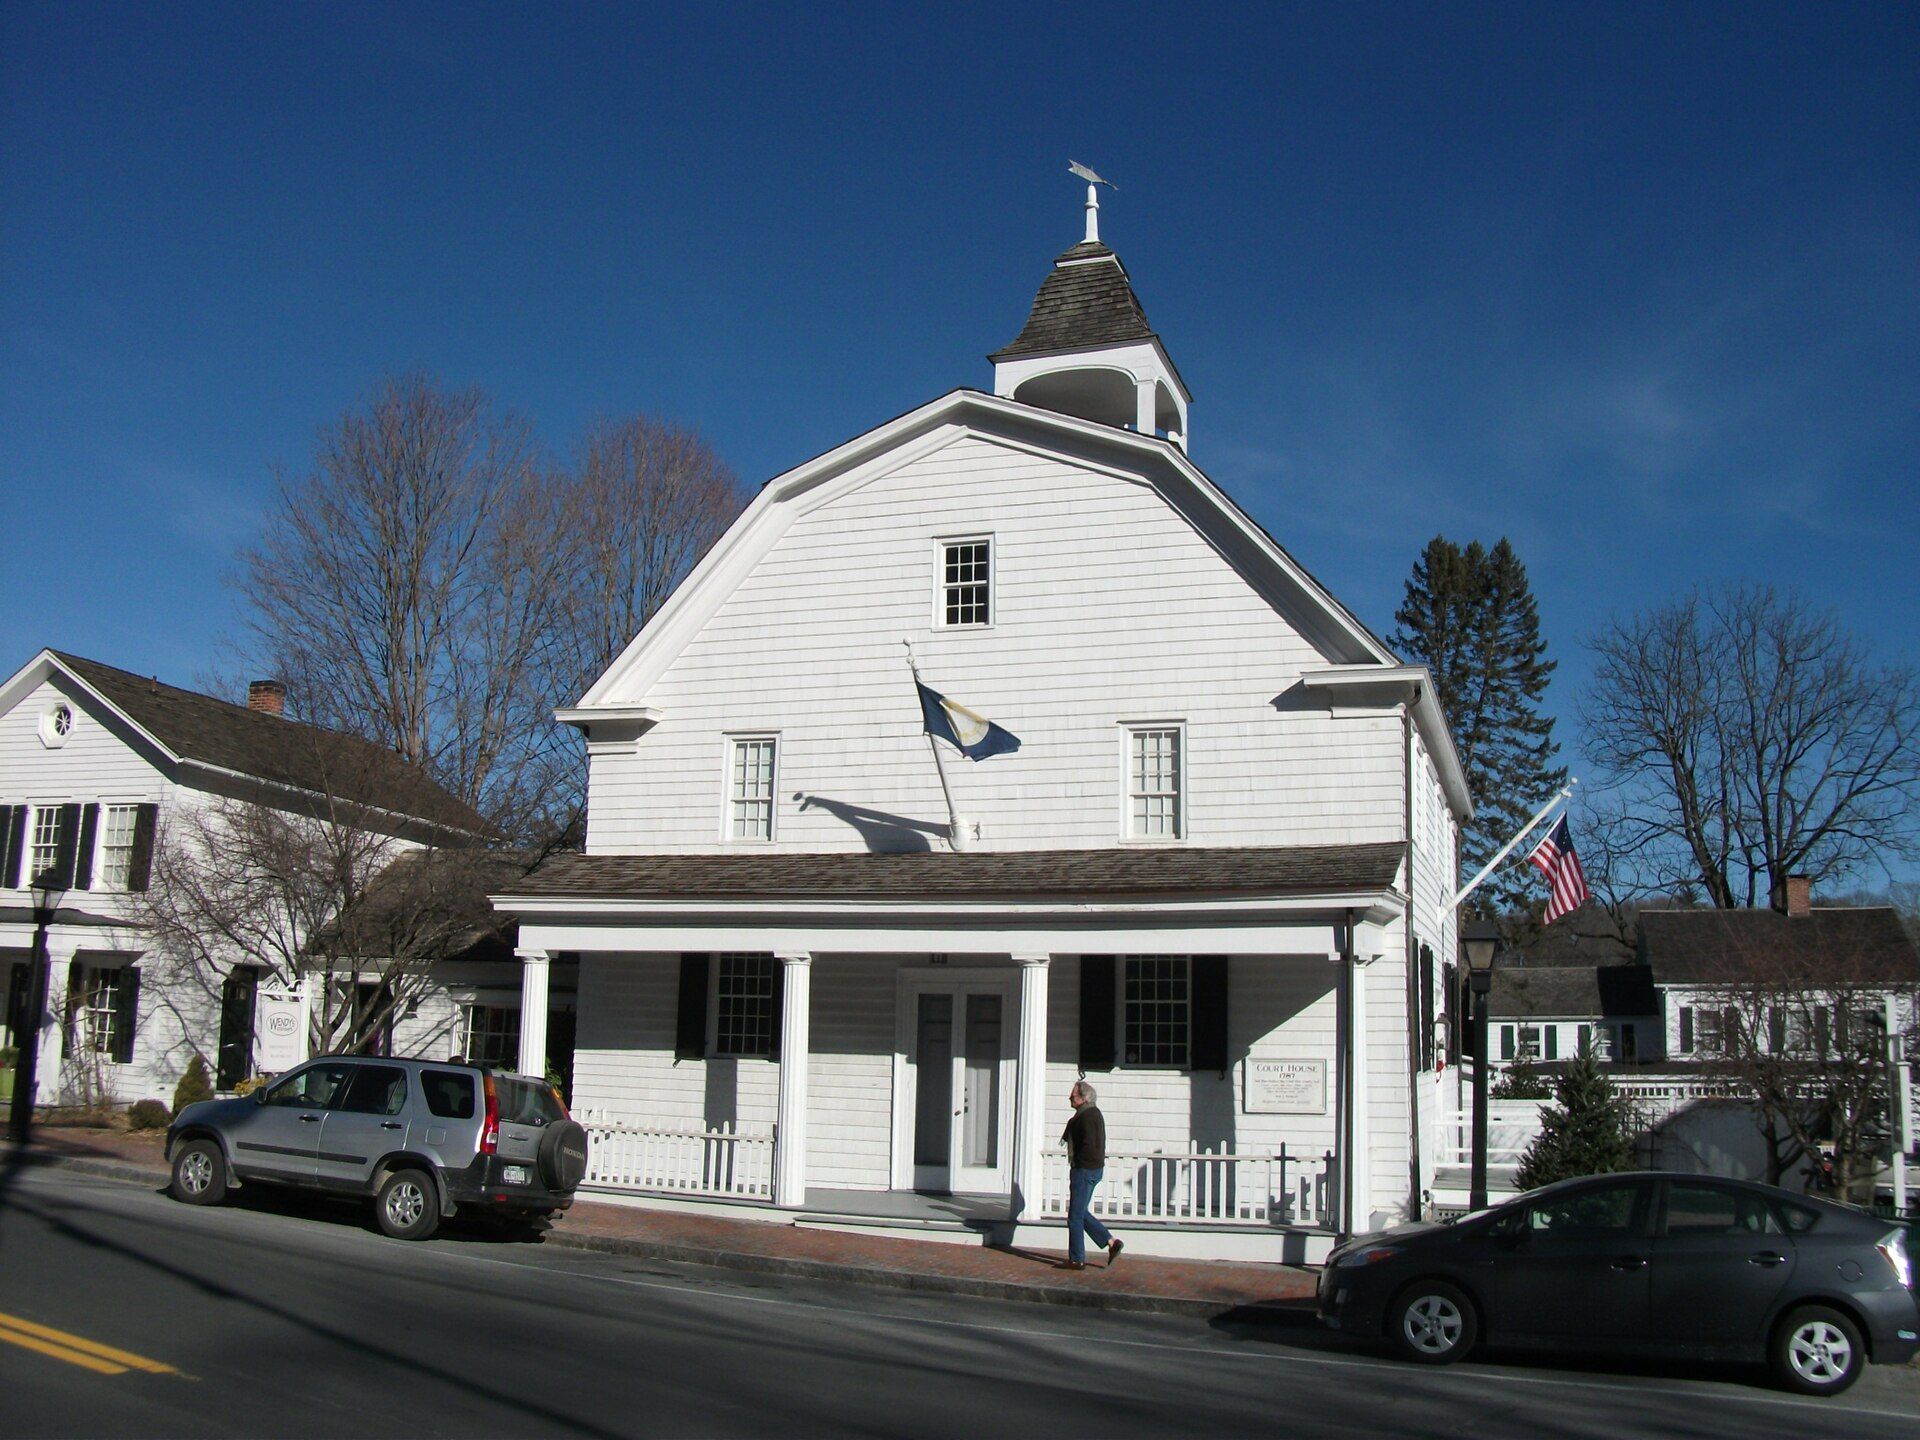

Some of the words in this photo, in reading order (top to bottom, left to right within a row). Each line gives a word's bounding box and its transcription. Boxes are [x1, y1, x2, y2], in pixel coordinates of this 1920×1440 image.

[1256, 1064, 1283, 1072] COURT
[1288, 1064, 1317, 1072] HOUSE
[563, 1146, 585, 1160] HONDA
